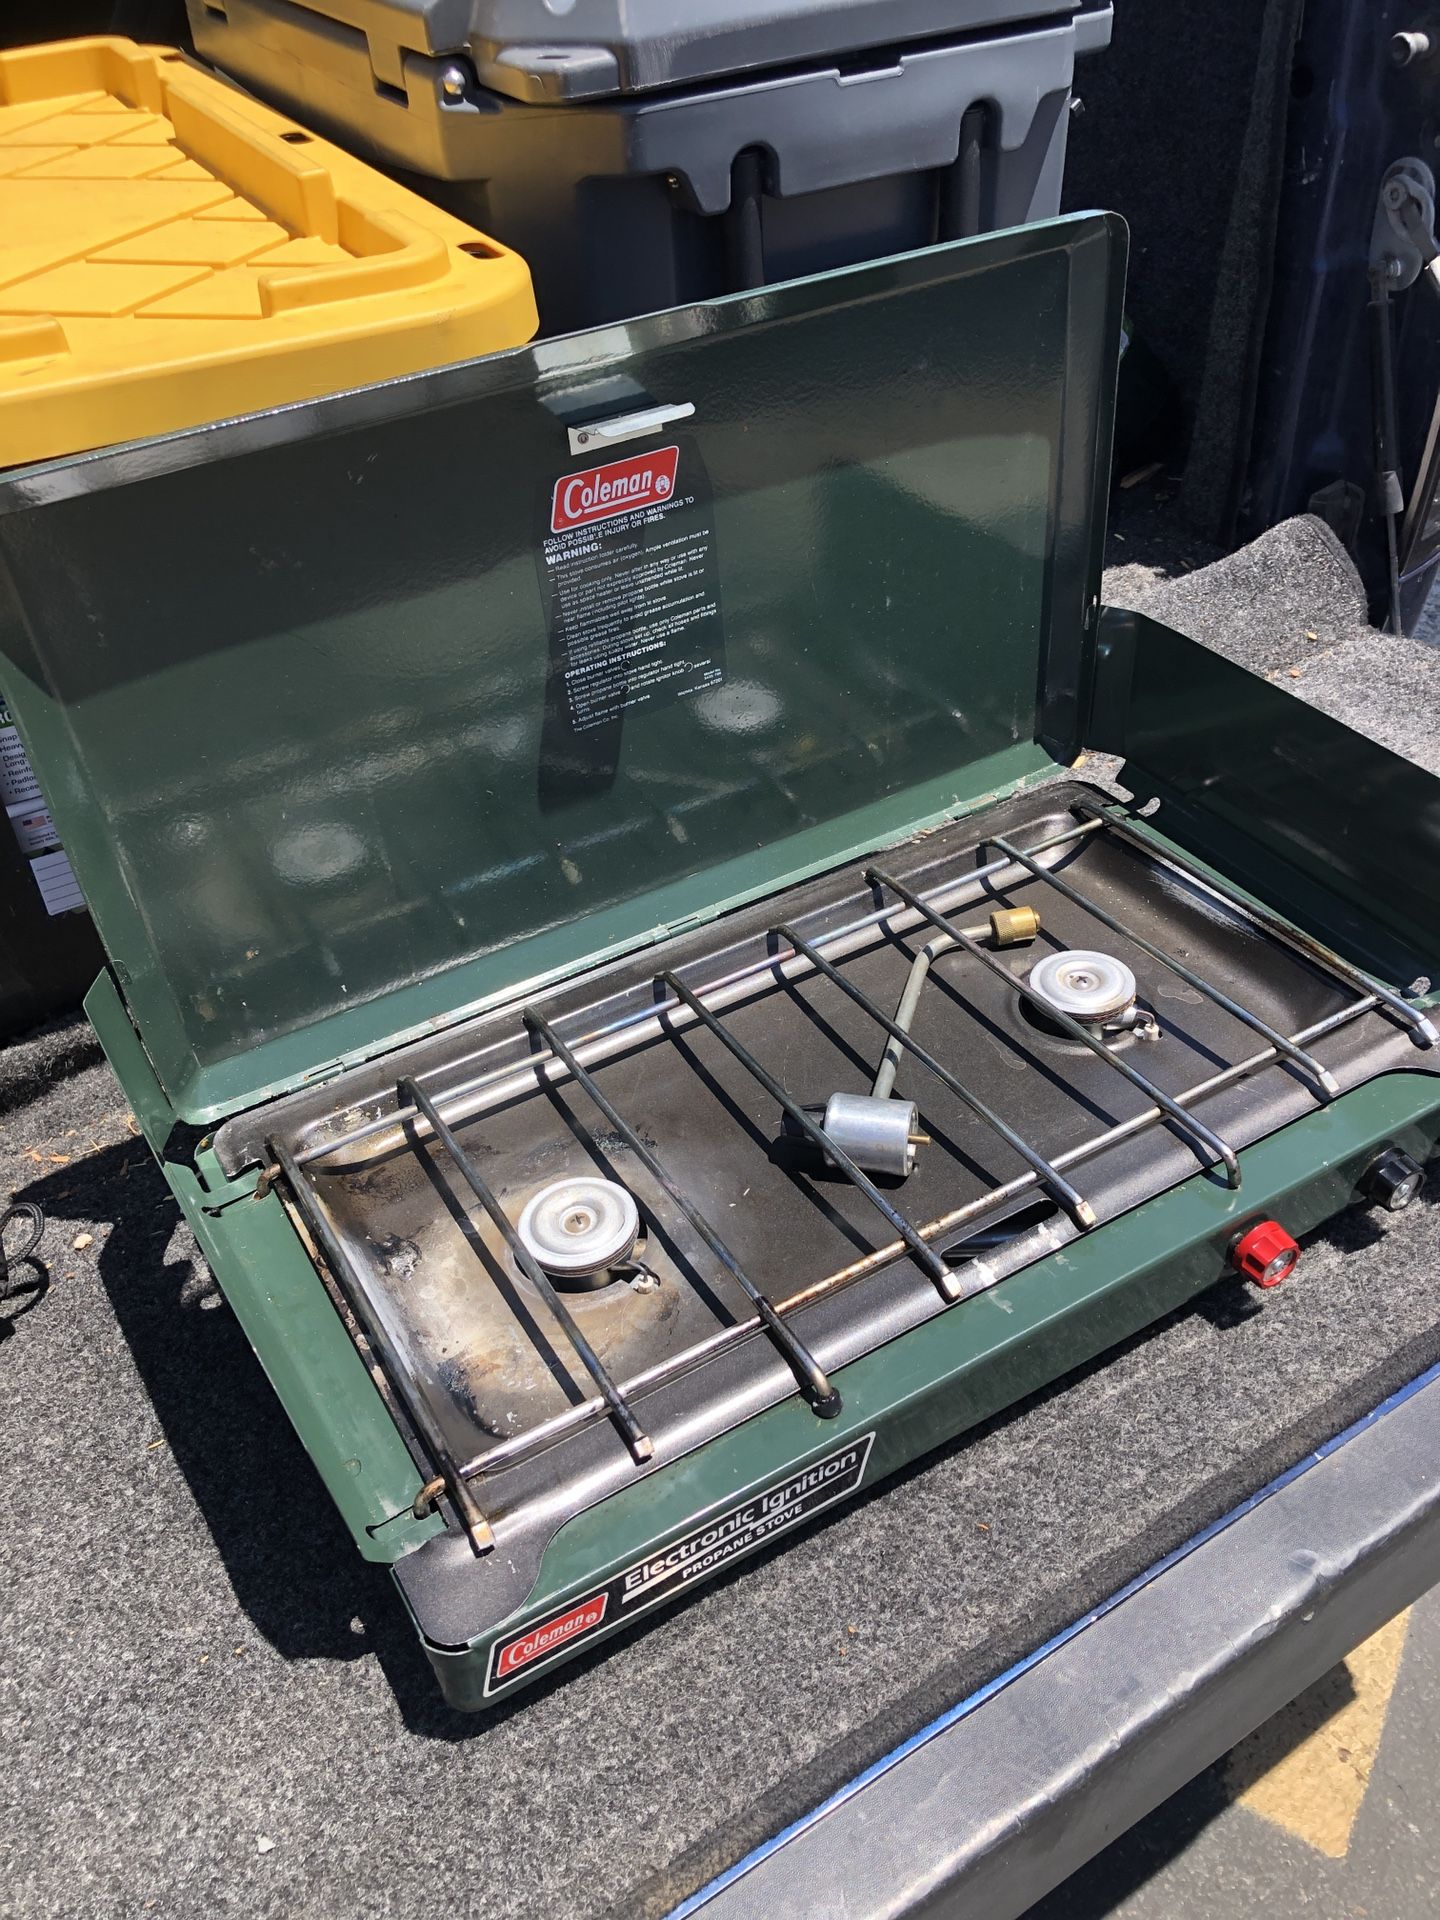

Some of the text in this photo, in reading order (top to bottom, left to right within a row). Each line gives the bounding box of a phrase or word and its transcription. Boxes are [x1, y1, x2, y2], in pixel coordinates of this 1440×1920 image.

[564, 470, 653, 519] Coleman
[542, 496, 694, 546] FOLLOW INSTRUCTIONS AND WARNINGS TO
[544, 512, 665, 554] AVOID POSSIBLE INJURY OR FIRES.
[545, 541, 602, 565] WARNING:
[556, 572, 568, 580] This
[645, 544, 661, 554] Ample
[579, 579, 600, 590] cooking
[614, 569, 630, 578] Never
[564, 659, 607, 678] OPERATING
[608, 640, 666, 664] INSTRUCTIONS:
[624, 1451, 857, 1592] Electronic Ignition
[682, 1502, 804, 1580] PROPANE STOVE
[508, 1613, 585, 1665] Coleman
